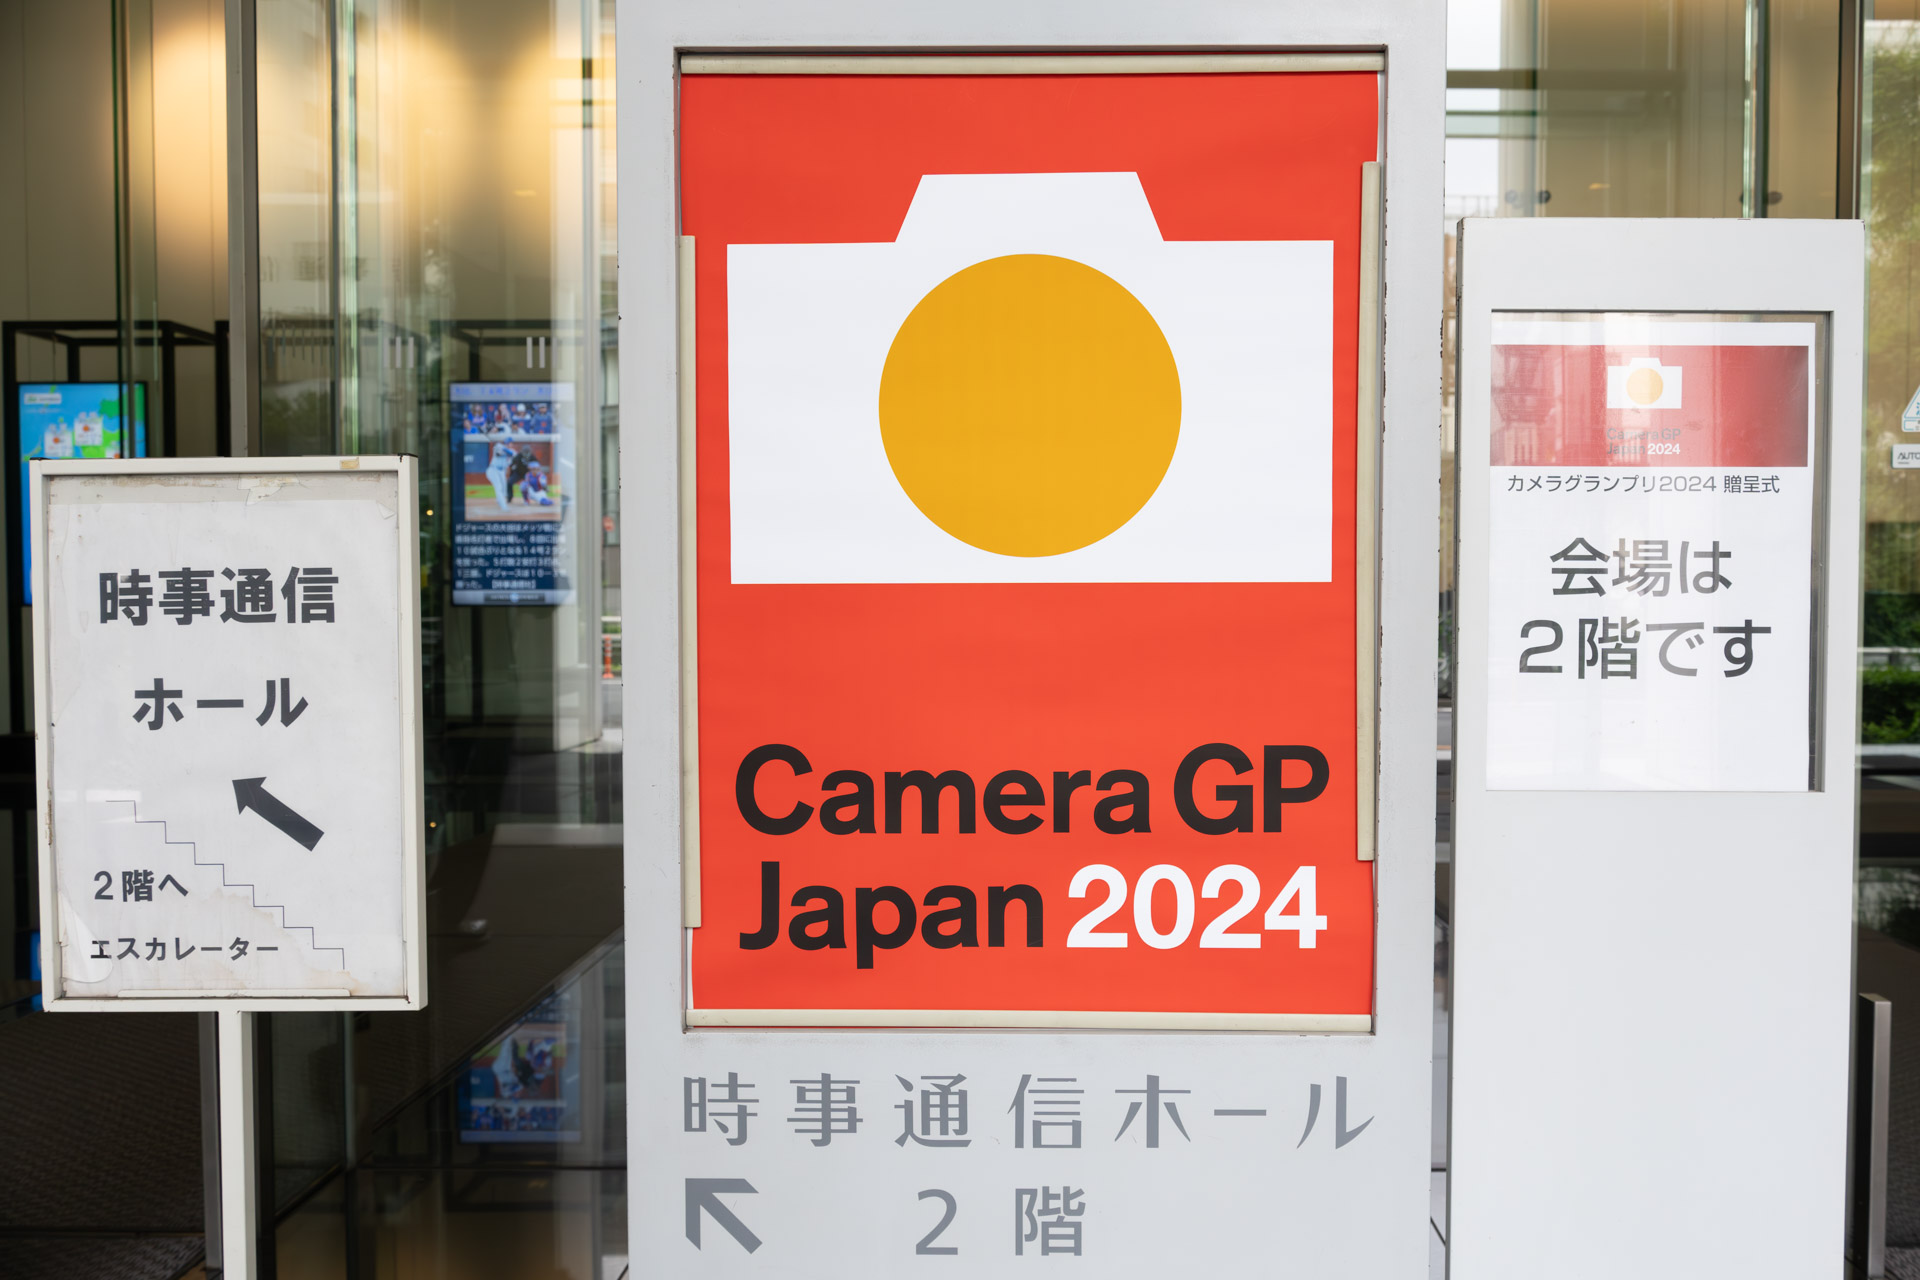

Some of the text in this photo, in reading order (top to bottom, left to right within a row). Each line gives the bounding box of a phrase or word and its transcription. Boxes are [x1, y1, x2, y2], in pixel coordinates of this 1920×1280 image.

[1607, 428, 1680, 440] Camera GP
[1607, 442, 1680, 456] Japan 2024
[1507, 474, 1780, 494] カメラグランプリ2024 贈呈式
[1549, 537, 1732, 597] 会場は
[100, 567, 339, 625] 時事通信
[1518, 615, 1771, 680] 2階です
[132, 677, 309, 731] ホール
[736, 742, 1330, 836] Camera GP
[94, 869, 189, 903] 2階へ
[739, 860, 1328, 970] Japan 2024
[90, 936, 279, 961] エスカレーター
[683, 1071, 1375, 1150] 時事通信ホール
